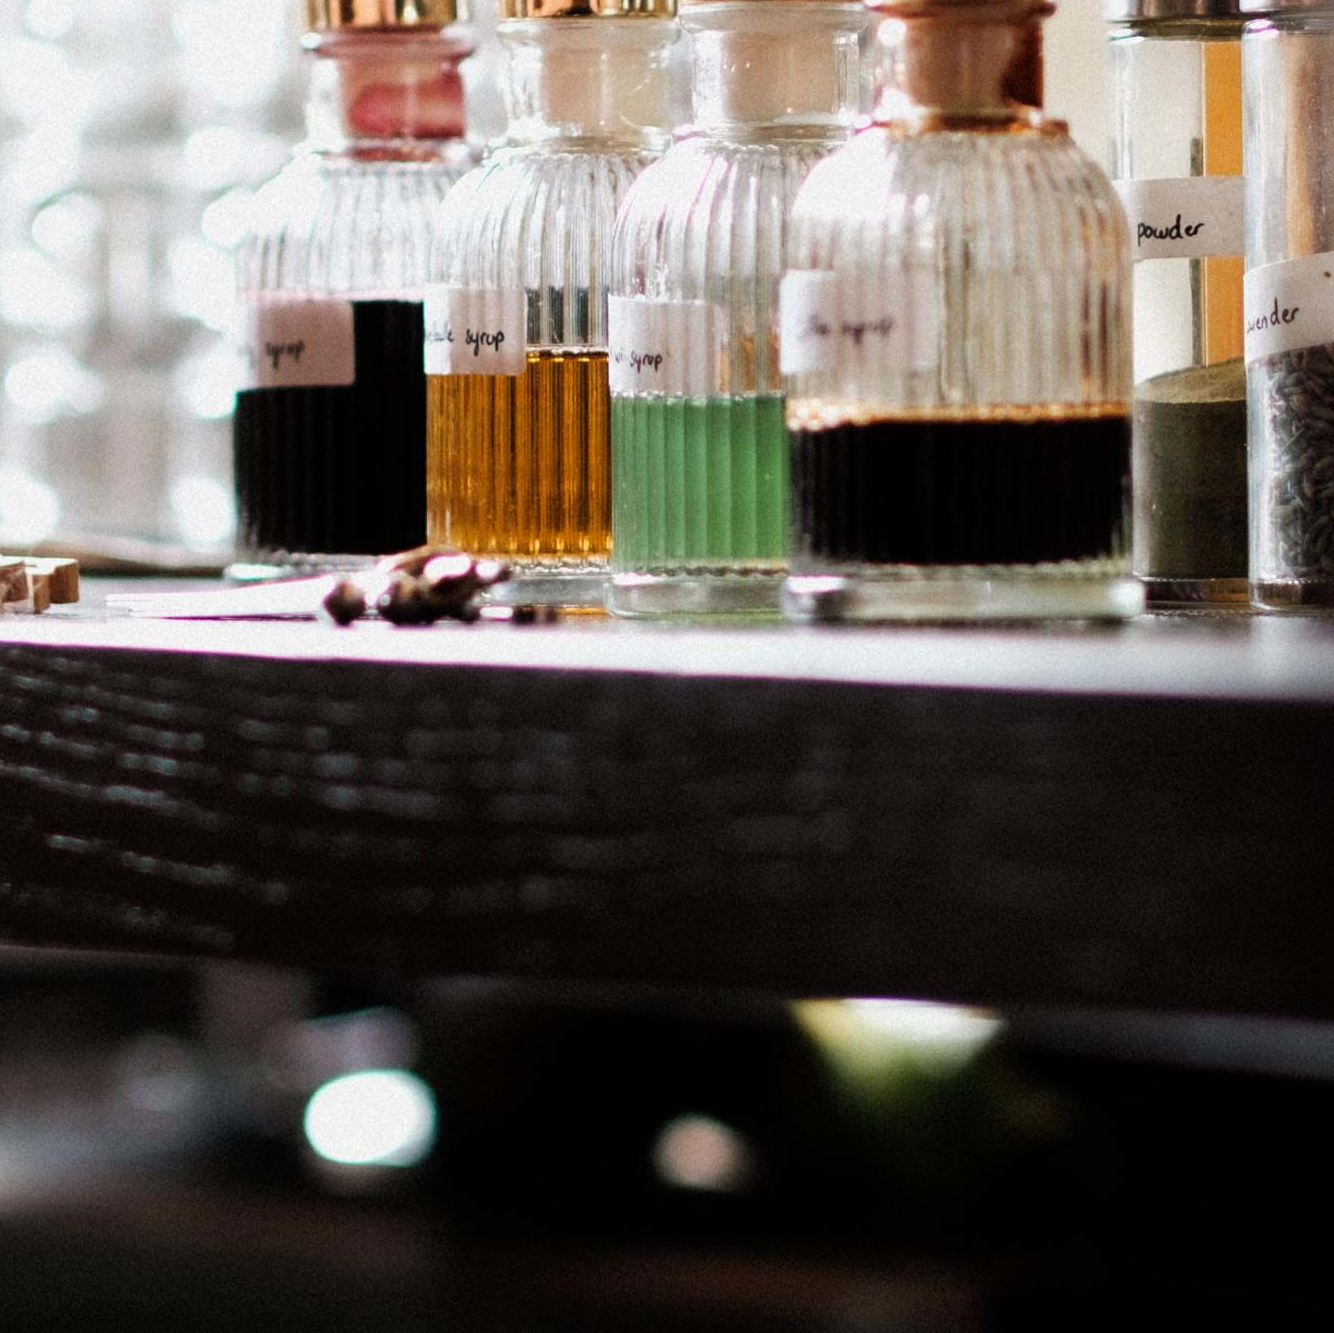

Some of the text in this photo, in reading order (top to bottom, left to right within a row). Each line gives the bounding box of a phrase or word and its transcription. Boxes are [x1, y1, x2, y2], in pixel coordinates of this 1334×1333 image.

[1137, 213, 1204, 247] powder
[465, 328, 505, 356] syrup
[629, 349, 663, 374] syrup
